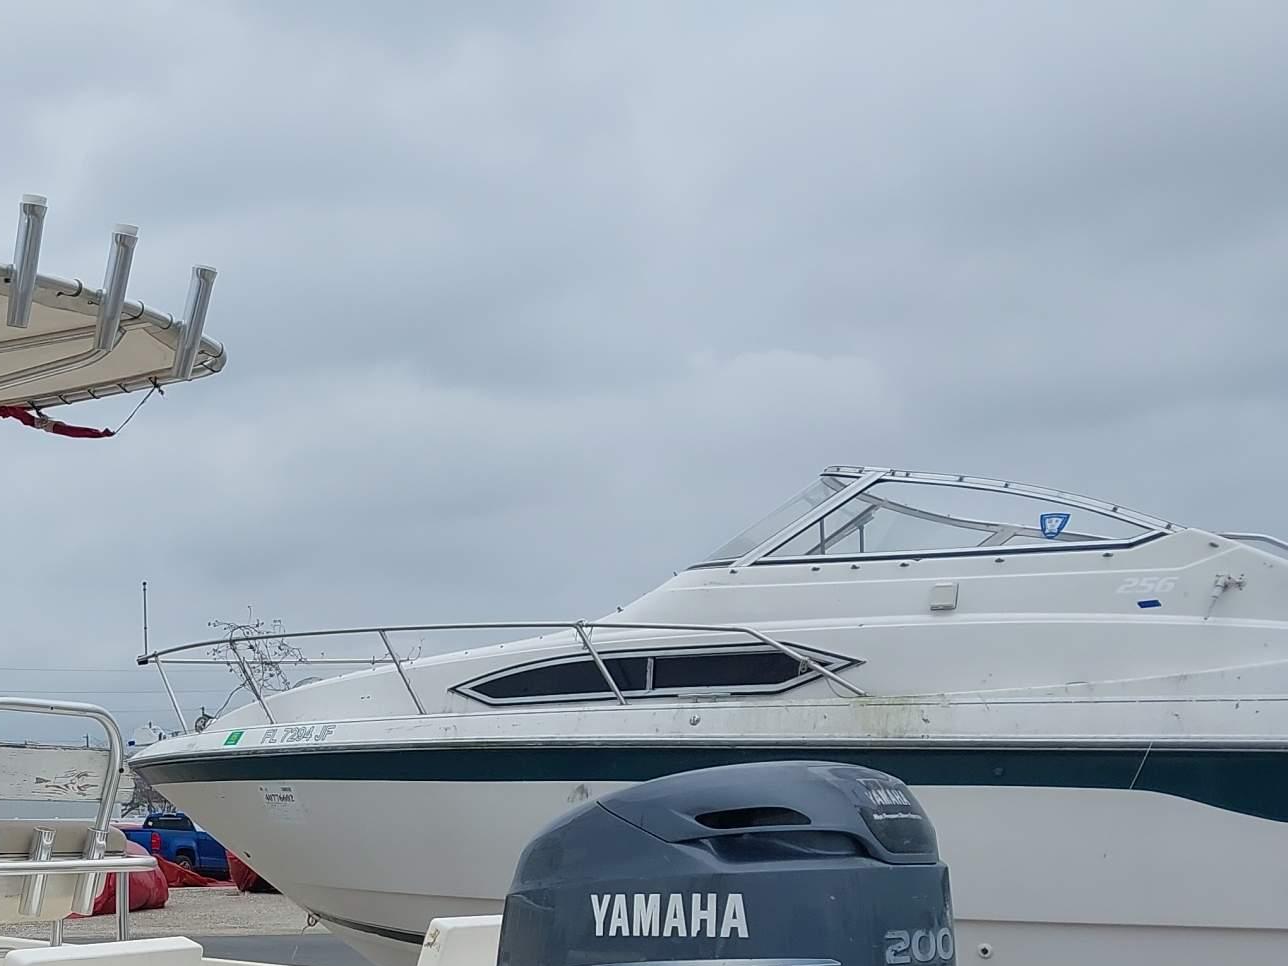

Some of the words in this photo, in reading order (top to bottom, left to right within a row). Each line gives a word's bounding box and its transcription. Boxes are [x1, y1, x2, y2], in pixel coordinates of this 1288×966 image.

[1116, 577, 1178, 593] 256
[261, 728, 278, 745] FL
[864, 788, 911, 806] YAMAHA
[590, 893, 750, 938] YAMAHA
[884, 927, 954, 965] 200
